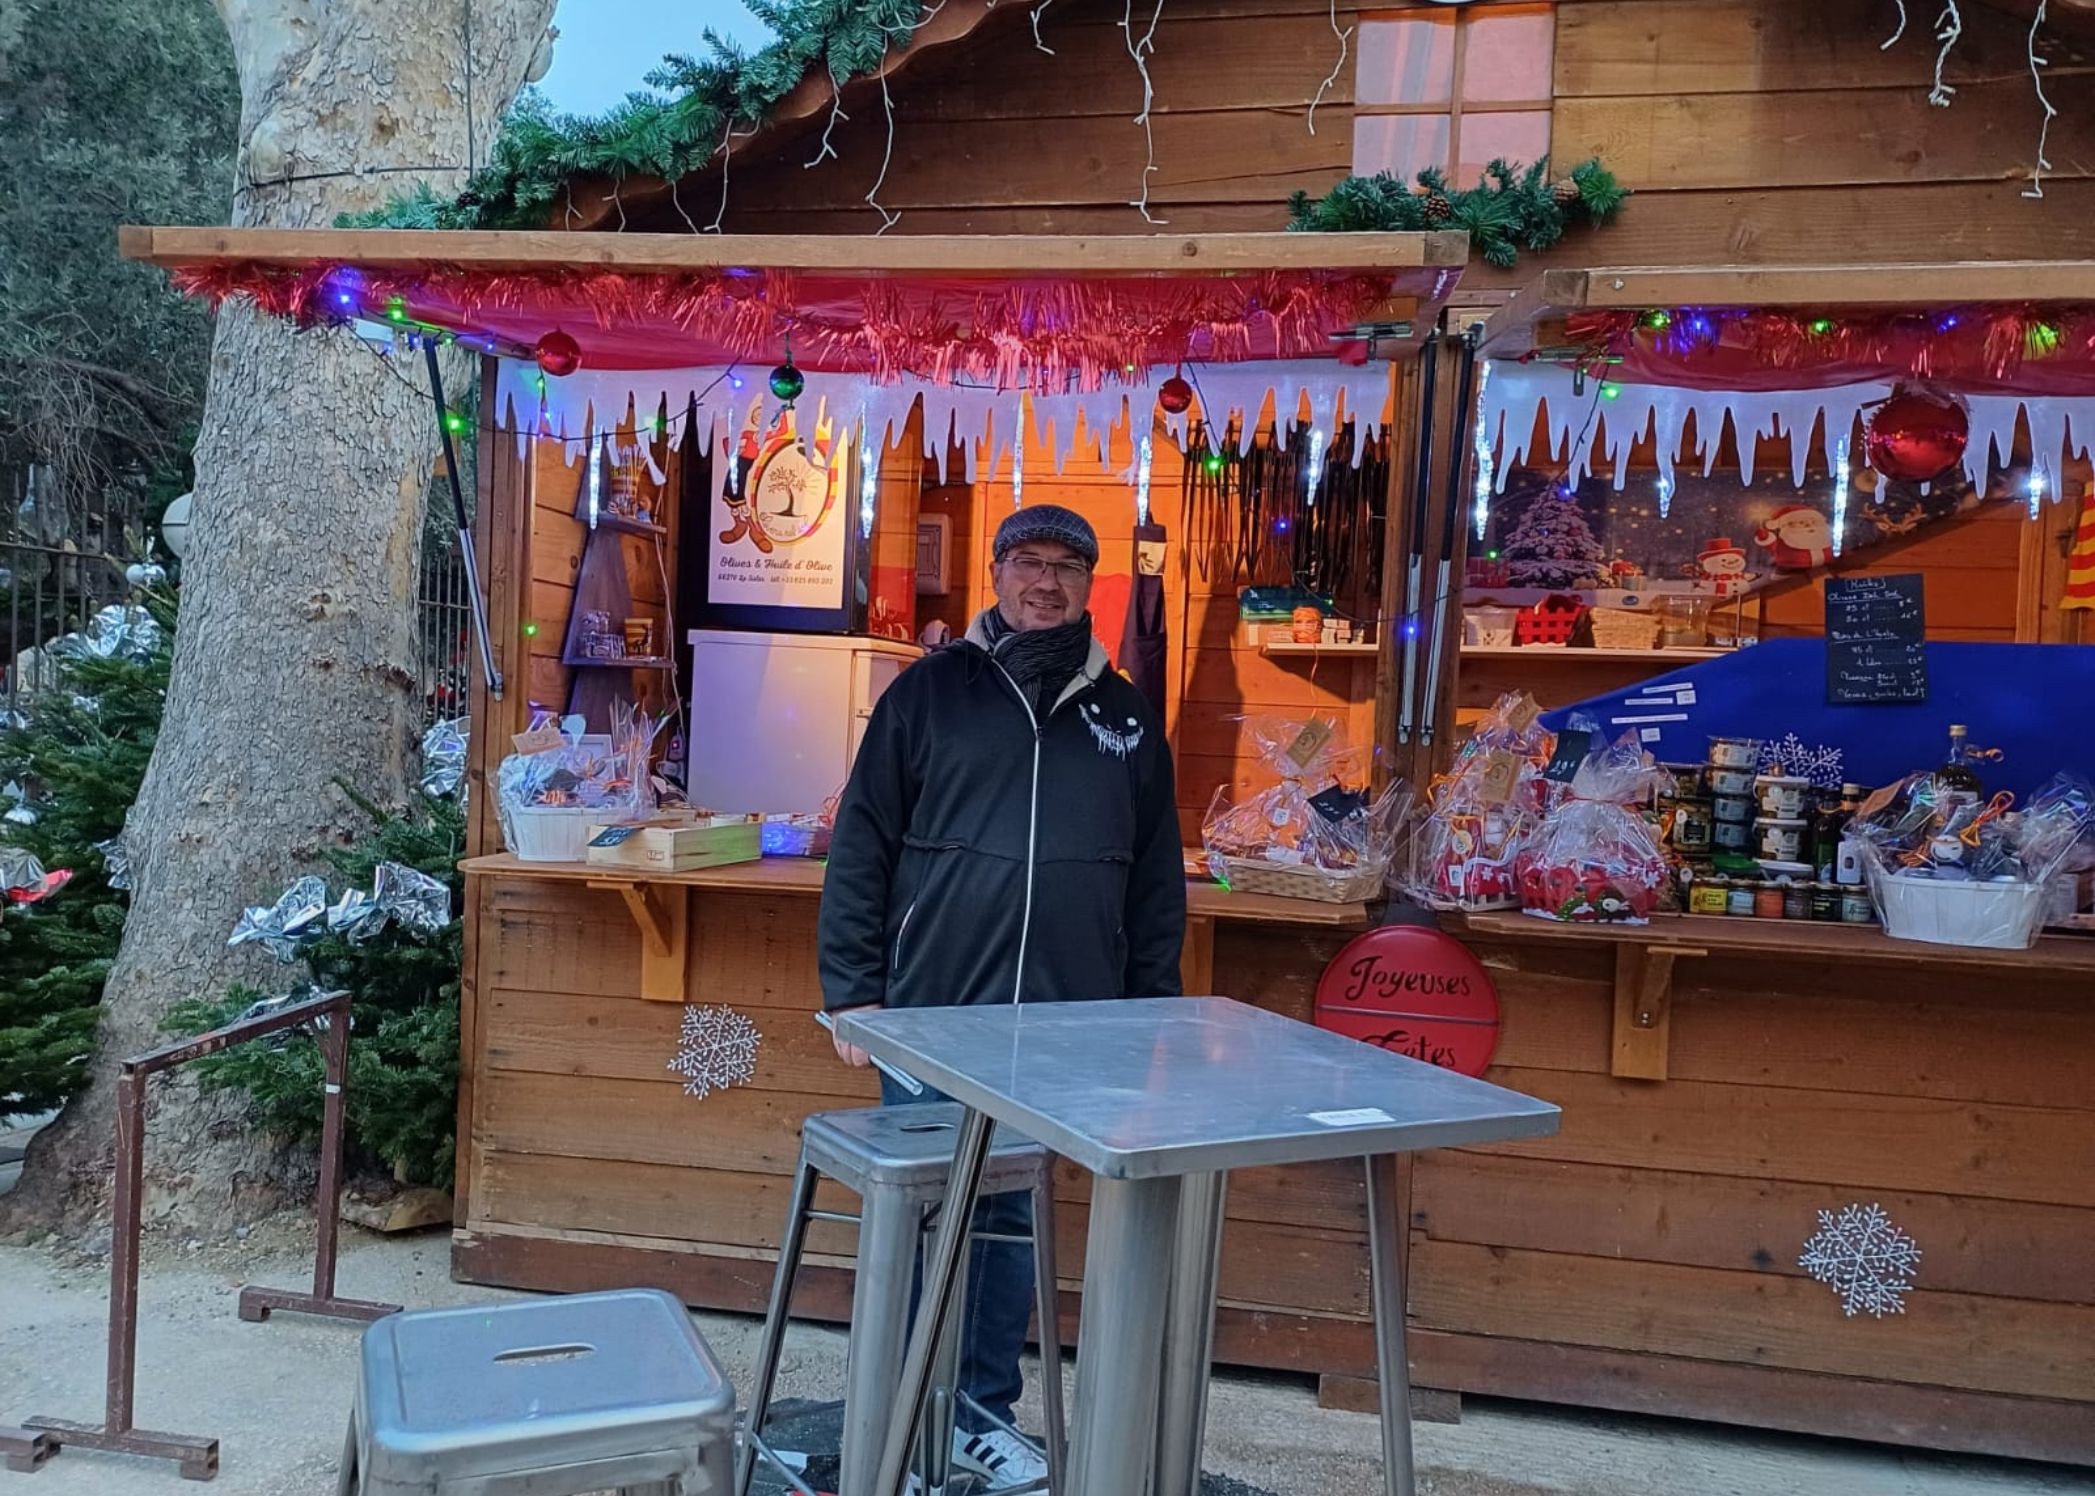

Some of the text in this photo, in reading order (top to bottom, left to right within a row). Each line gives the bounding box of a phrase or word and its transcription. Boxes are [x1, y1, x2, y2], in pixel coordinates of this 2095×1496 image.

[720, 556, 752, 568] Olives
[754, 558, 761, 568] &
[764, 559, 794, 570] Huile
[806, 560, 832, 571] Olive
[1345, 955, 1472, 1001] Joyeuses
